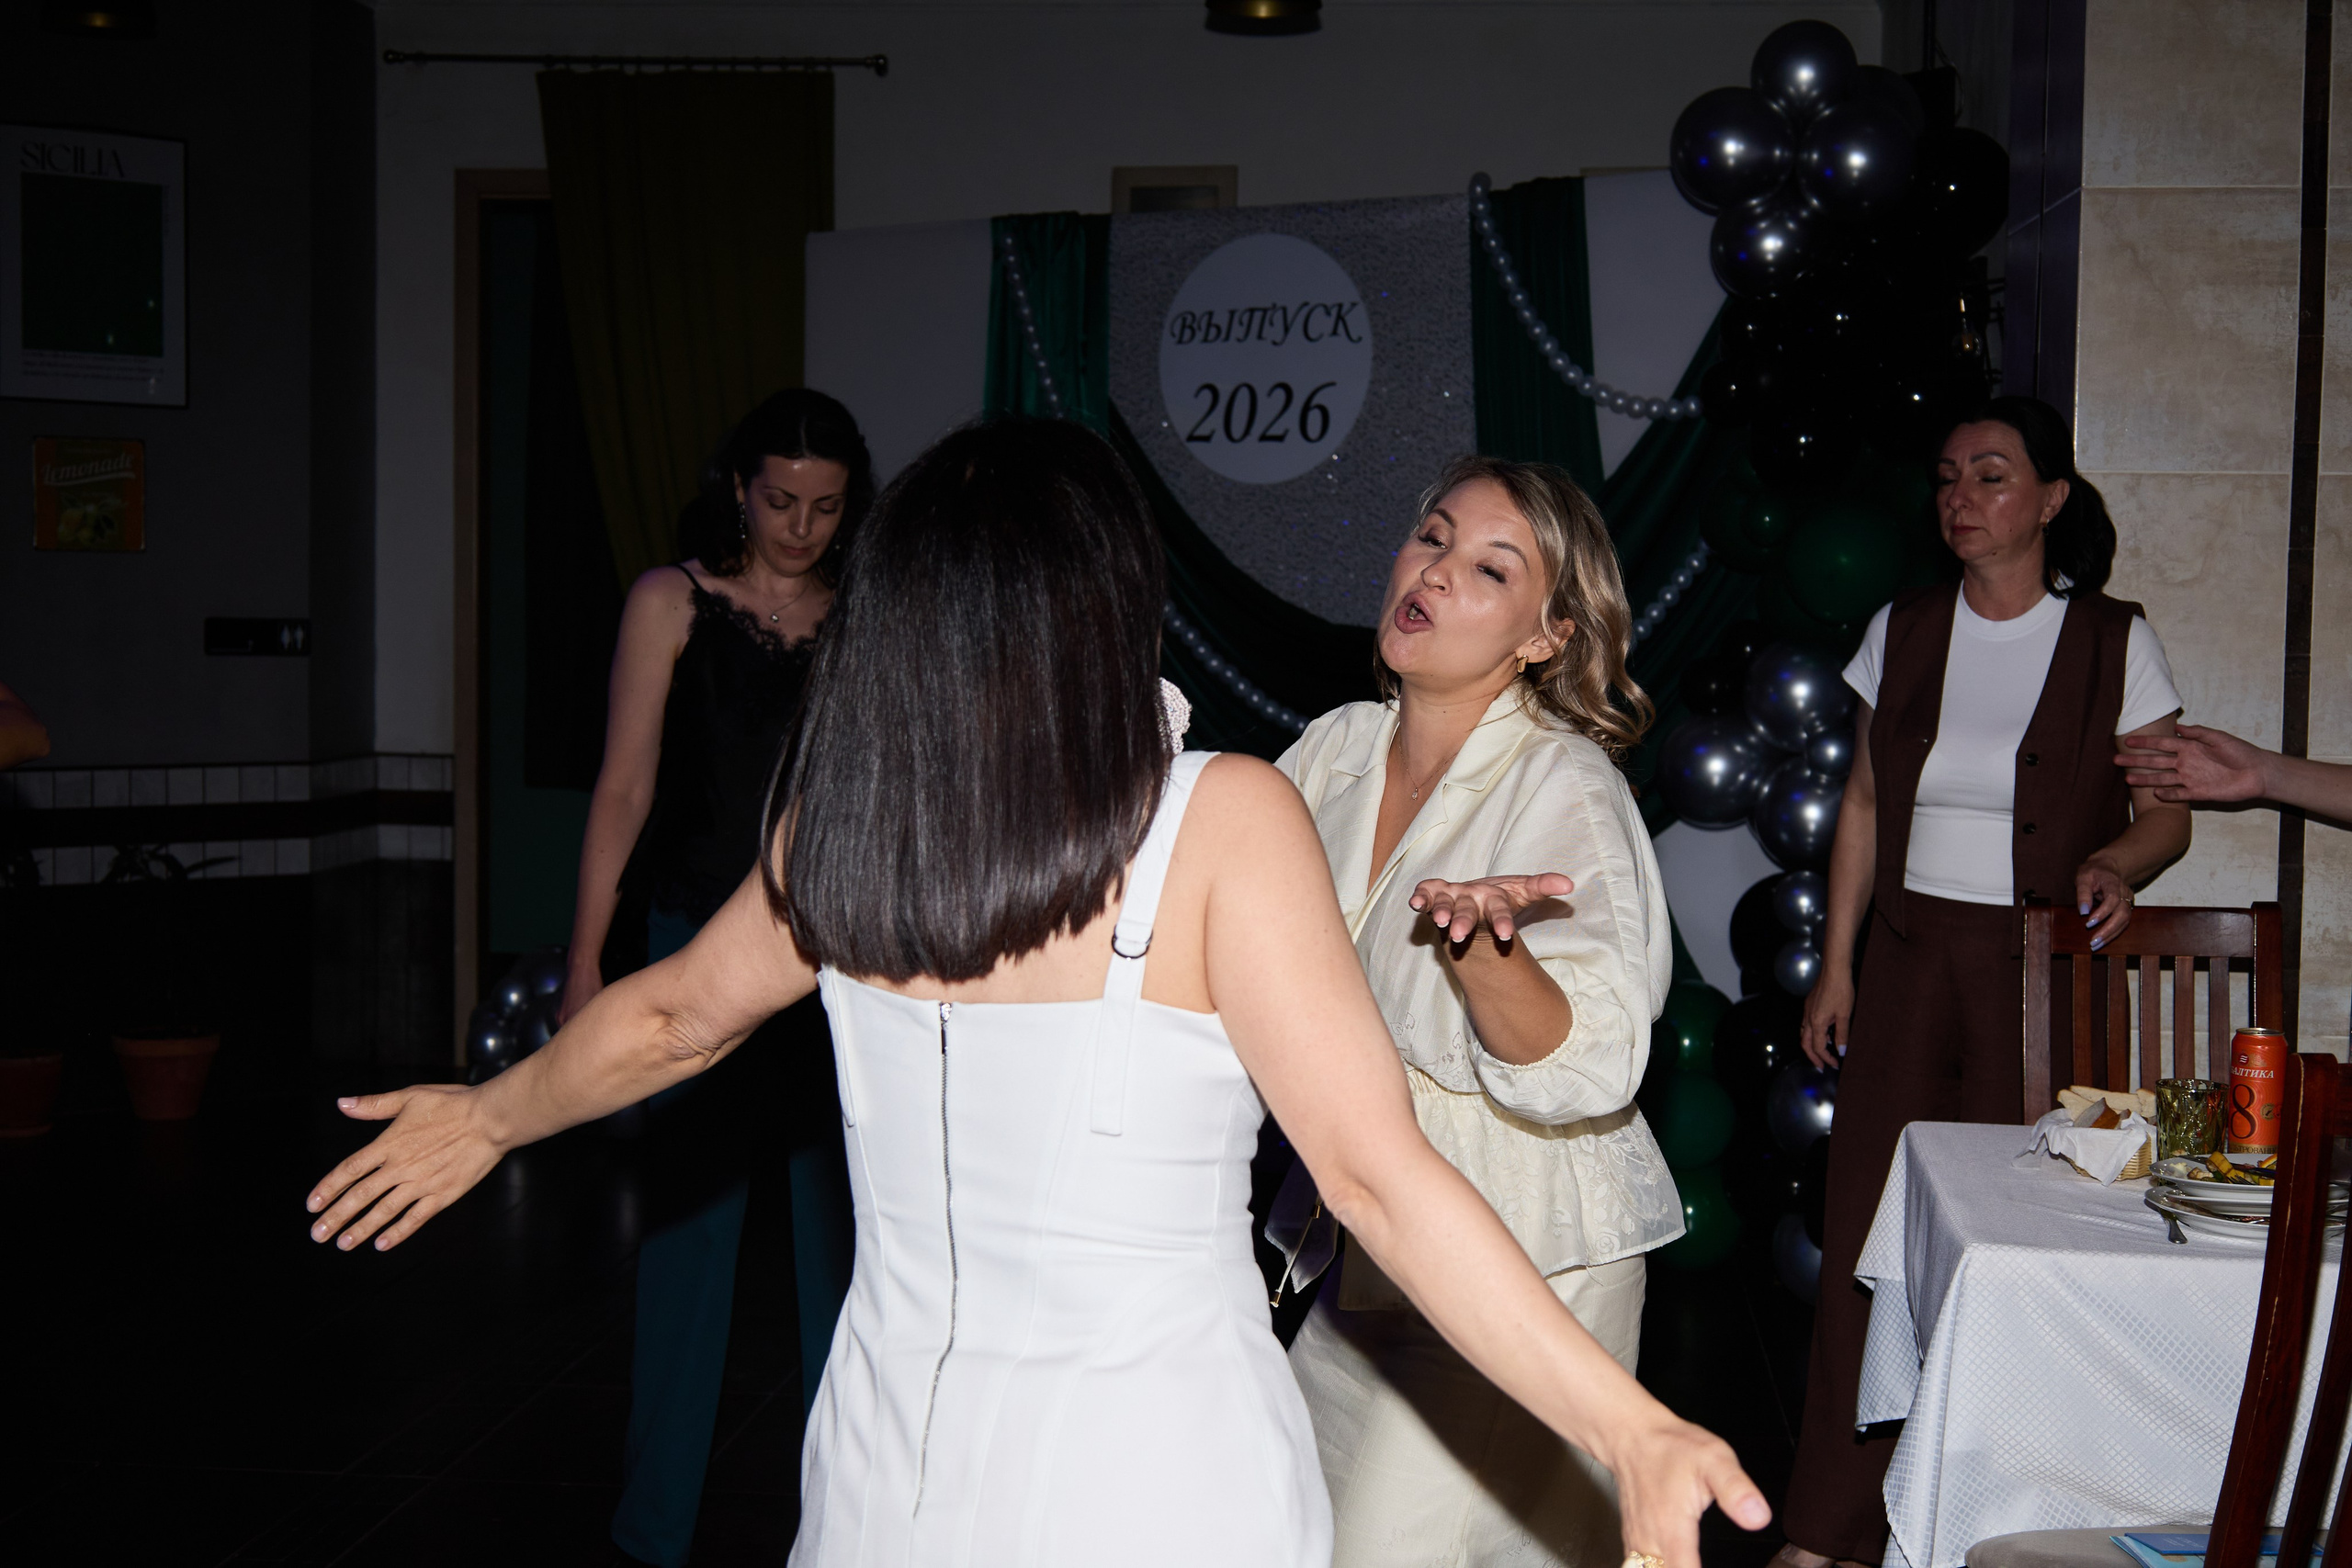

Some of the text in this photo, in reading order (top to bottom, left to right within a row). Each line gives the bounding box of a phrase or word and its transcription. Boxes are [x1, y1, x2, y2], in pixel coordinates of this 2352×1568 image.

[20, 140, 124, 178] SICILIA
[1170, 301, 1363, 346] ВЫПУСК
[1186, 381, 1337, 444] 2026
[40, 452, 135, 485] Lemonade
[2231, 1084, 2256, 1139] 8
